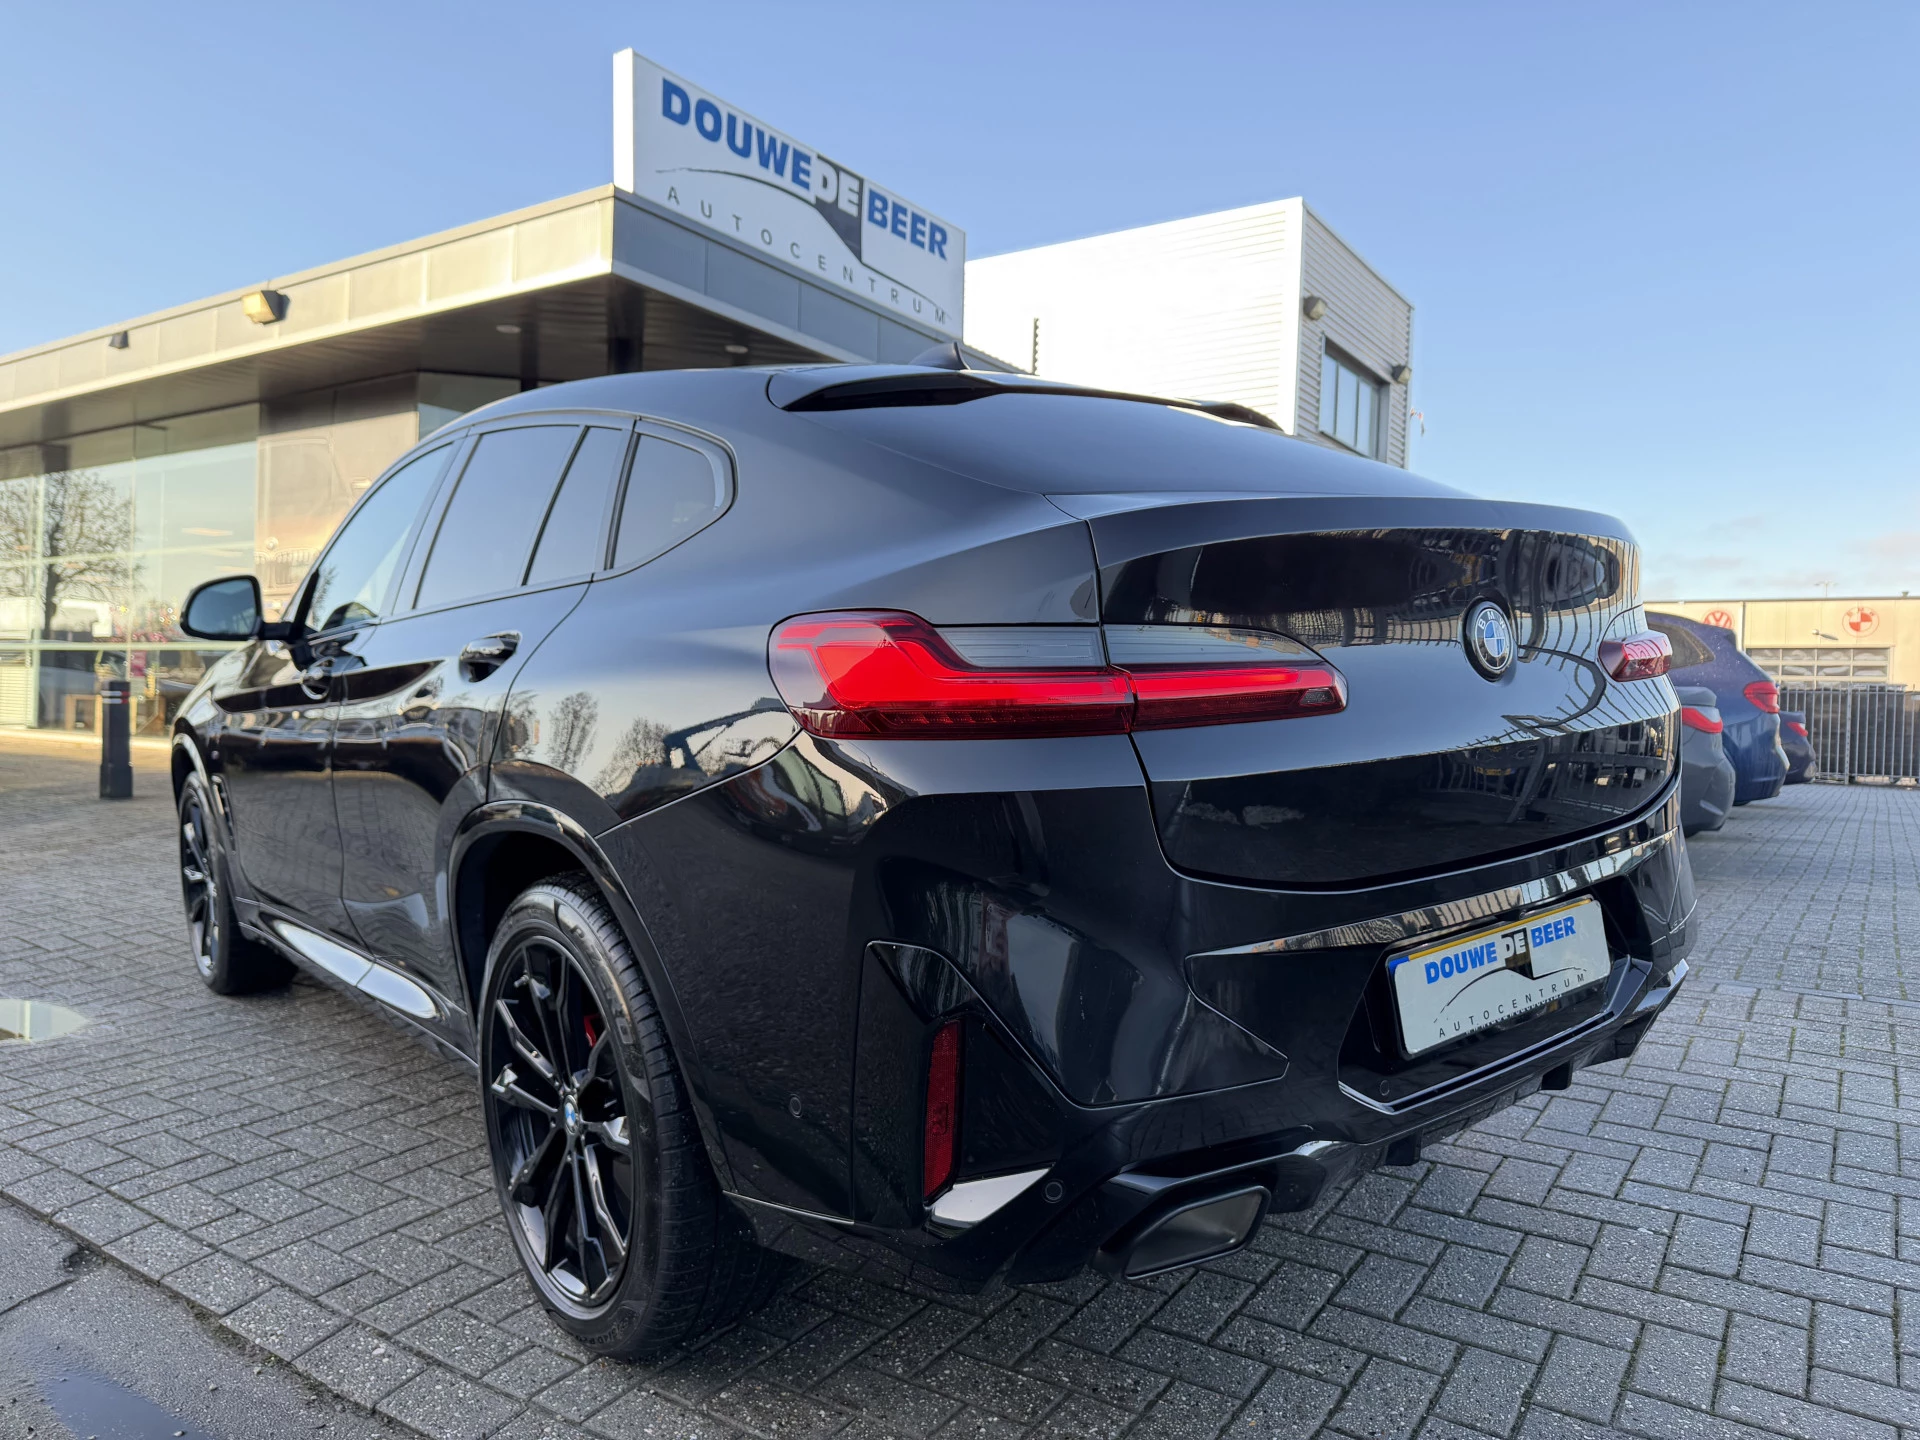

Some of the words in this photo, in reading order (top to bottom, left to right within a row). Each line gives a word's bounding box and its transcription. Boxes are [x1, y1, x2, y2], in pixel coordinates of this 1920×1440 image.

[661, 77, 812, 191] DOUWE
[811, 155, 860, 218] DE
[867, 188, 948, 261] BEER
[667, 185, 946, 325] AUTOCENTRUM
[1424, 941, 1498, 985] DOUWE
[1501, 931, 1527, 960] DE
[1530, 916, 1577, 949] BEER
[1439, 973, 1585, 1039] AUTOCENTRUM
